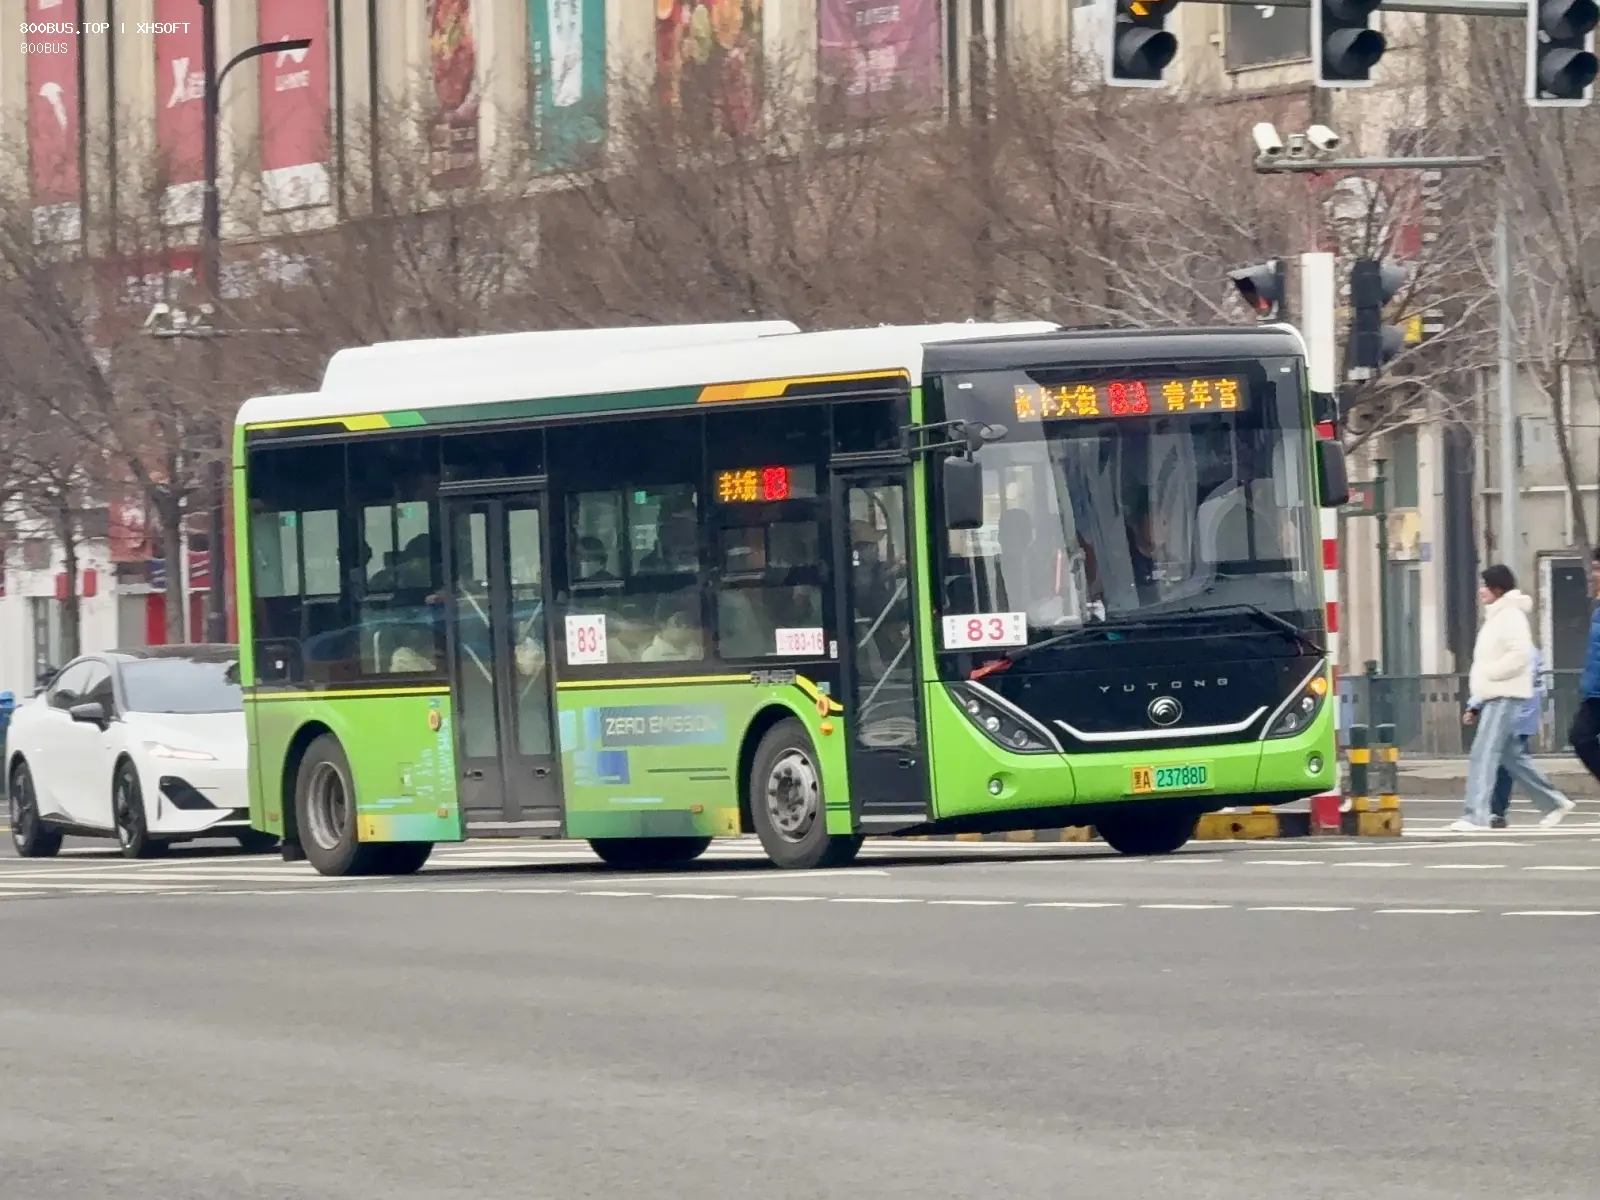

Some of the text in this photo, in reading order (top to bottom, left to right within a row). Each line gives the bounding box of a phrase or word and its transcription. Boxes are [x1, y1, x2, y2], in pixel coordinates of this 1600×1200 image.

[577, 626, 597, 653] 83
[966, 617, 1004, 642] 83
[1099, 677, 1228, 693] YUTONG
[605, 716, 645, 735] ZERO
[1156, 766, 1207, 788] 23788D
